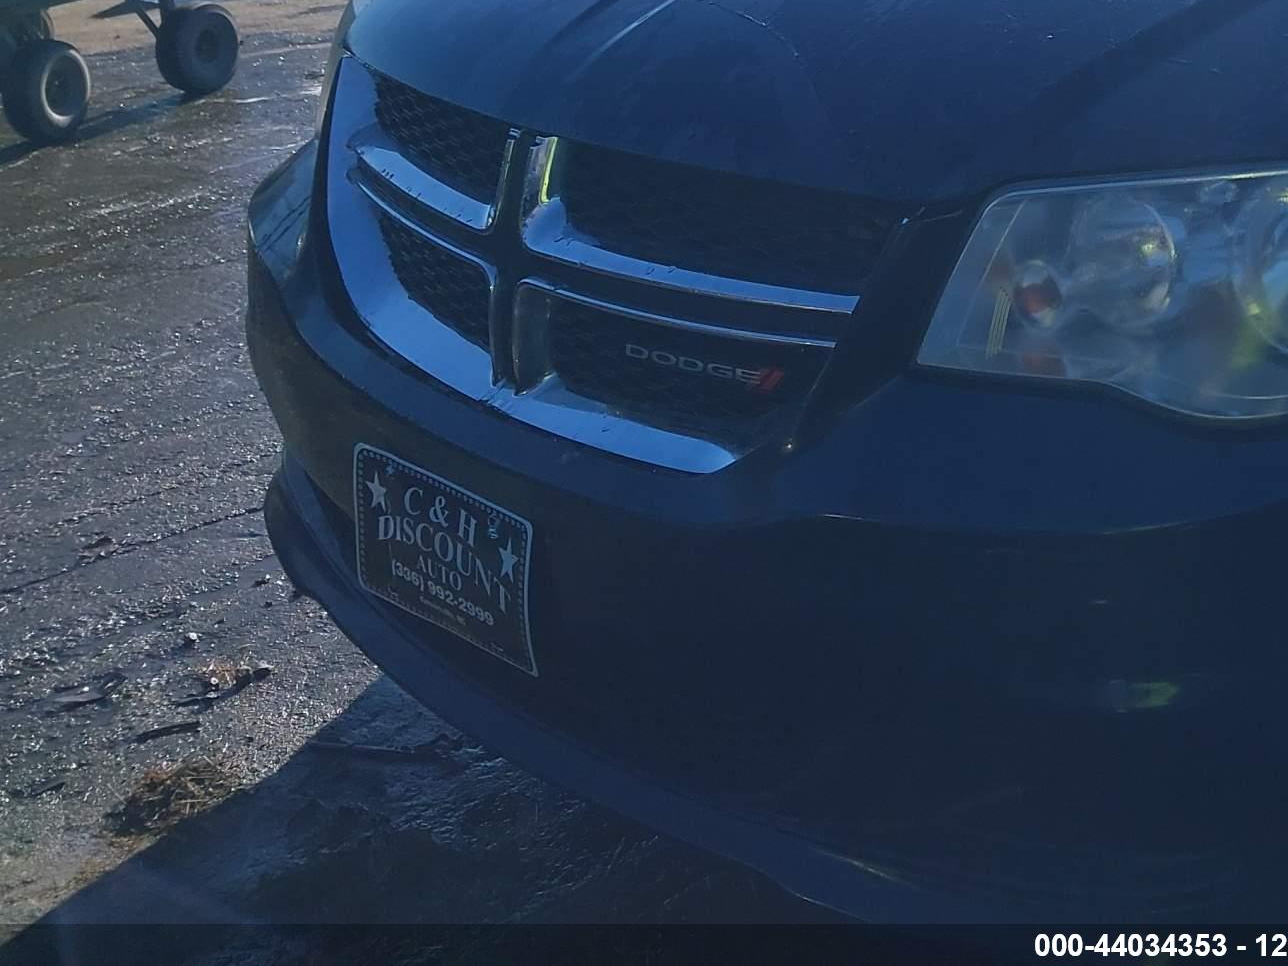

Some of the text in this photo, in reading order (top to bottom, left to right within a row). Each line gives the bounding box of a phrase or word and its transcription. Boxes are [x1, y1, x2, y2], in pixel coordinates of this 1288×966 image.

[625, 343, 761, 384] DODGE
[404, 487, 423, 515] C
[429, 495, 449, 528] &
[458, 508, 477, 547] H
[377, 515, 511, 614] DISCOUNT
[416, 555, 462, 592] AUTO
